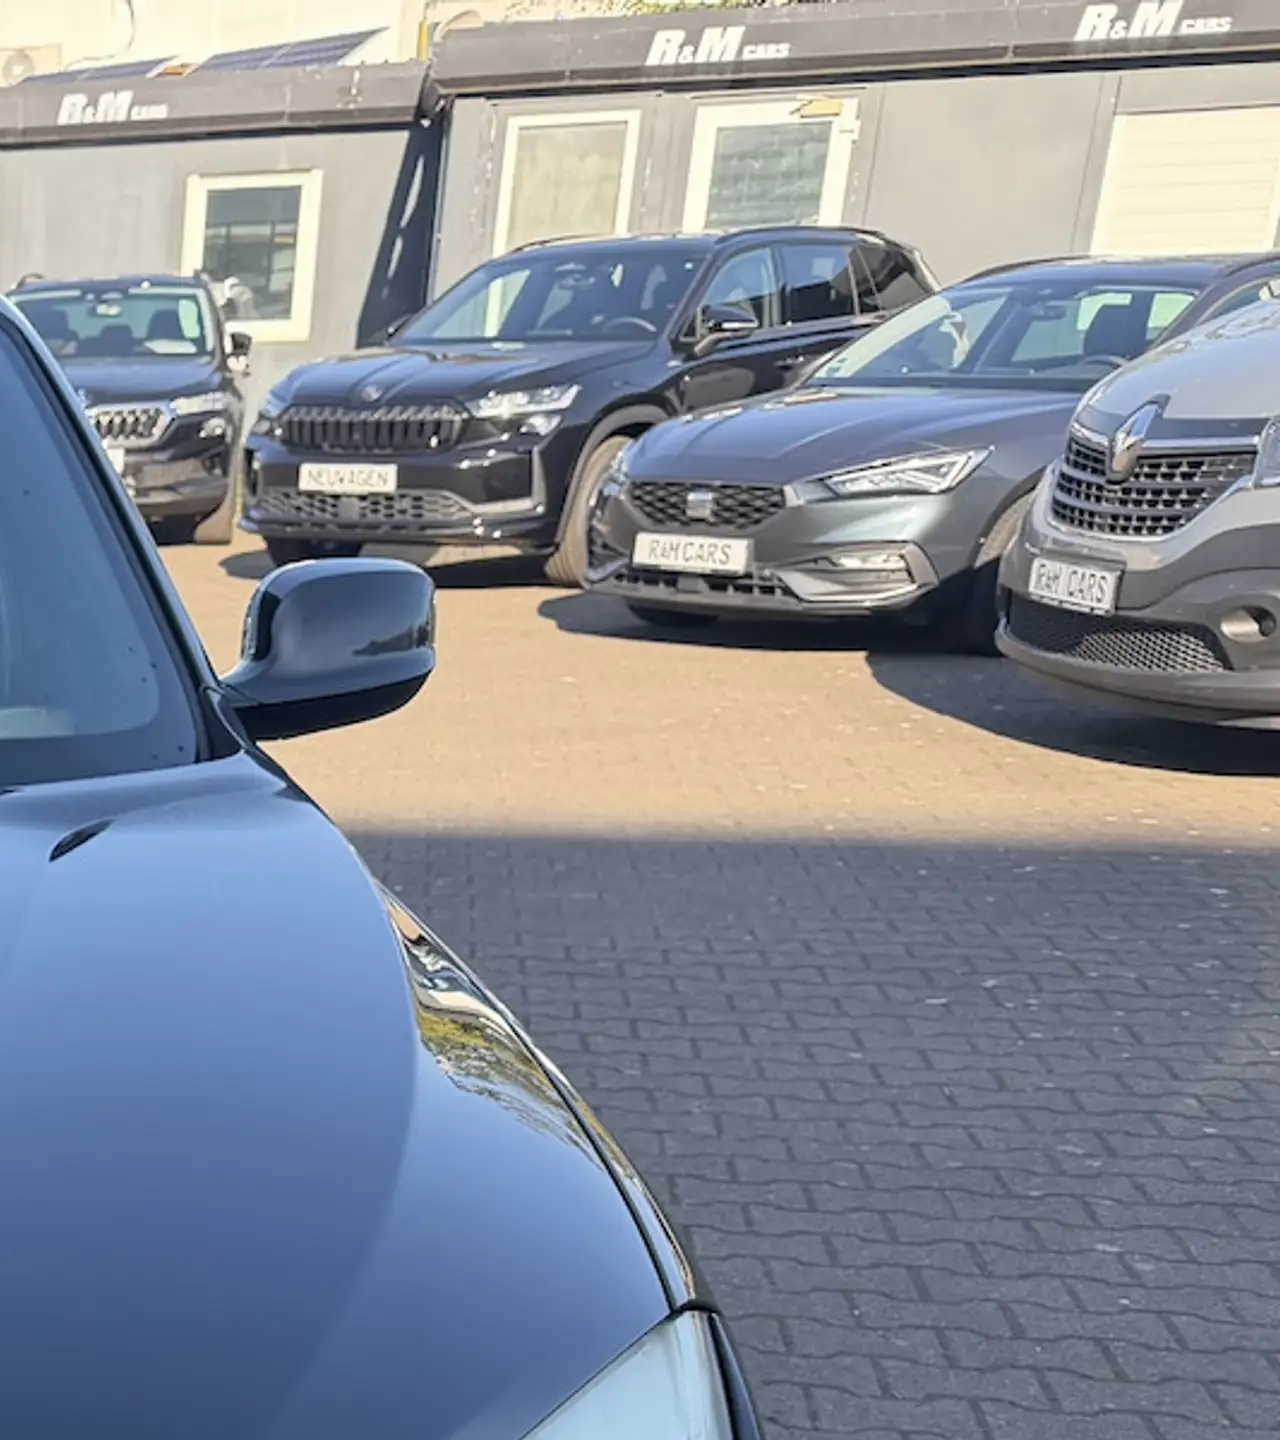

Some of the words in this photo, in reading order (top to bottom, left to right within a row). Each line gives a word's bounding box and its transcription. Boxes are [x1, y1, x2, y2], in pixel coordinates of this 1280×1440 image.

[1074, 0, 1184, 41] R&M
[645, 25, 746, 67] R&M
[682, 541, 731, 566] CARS
